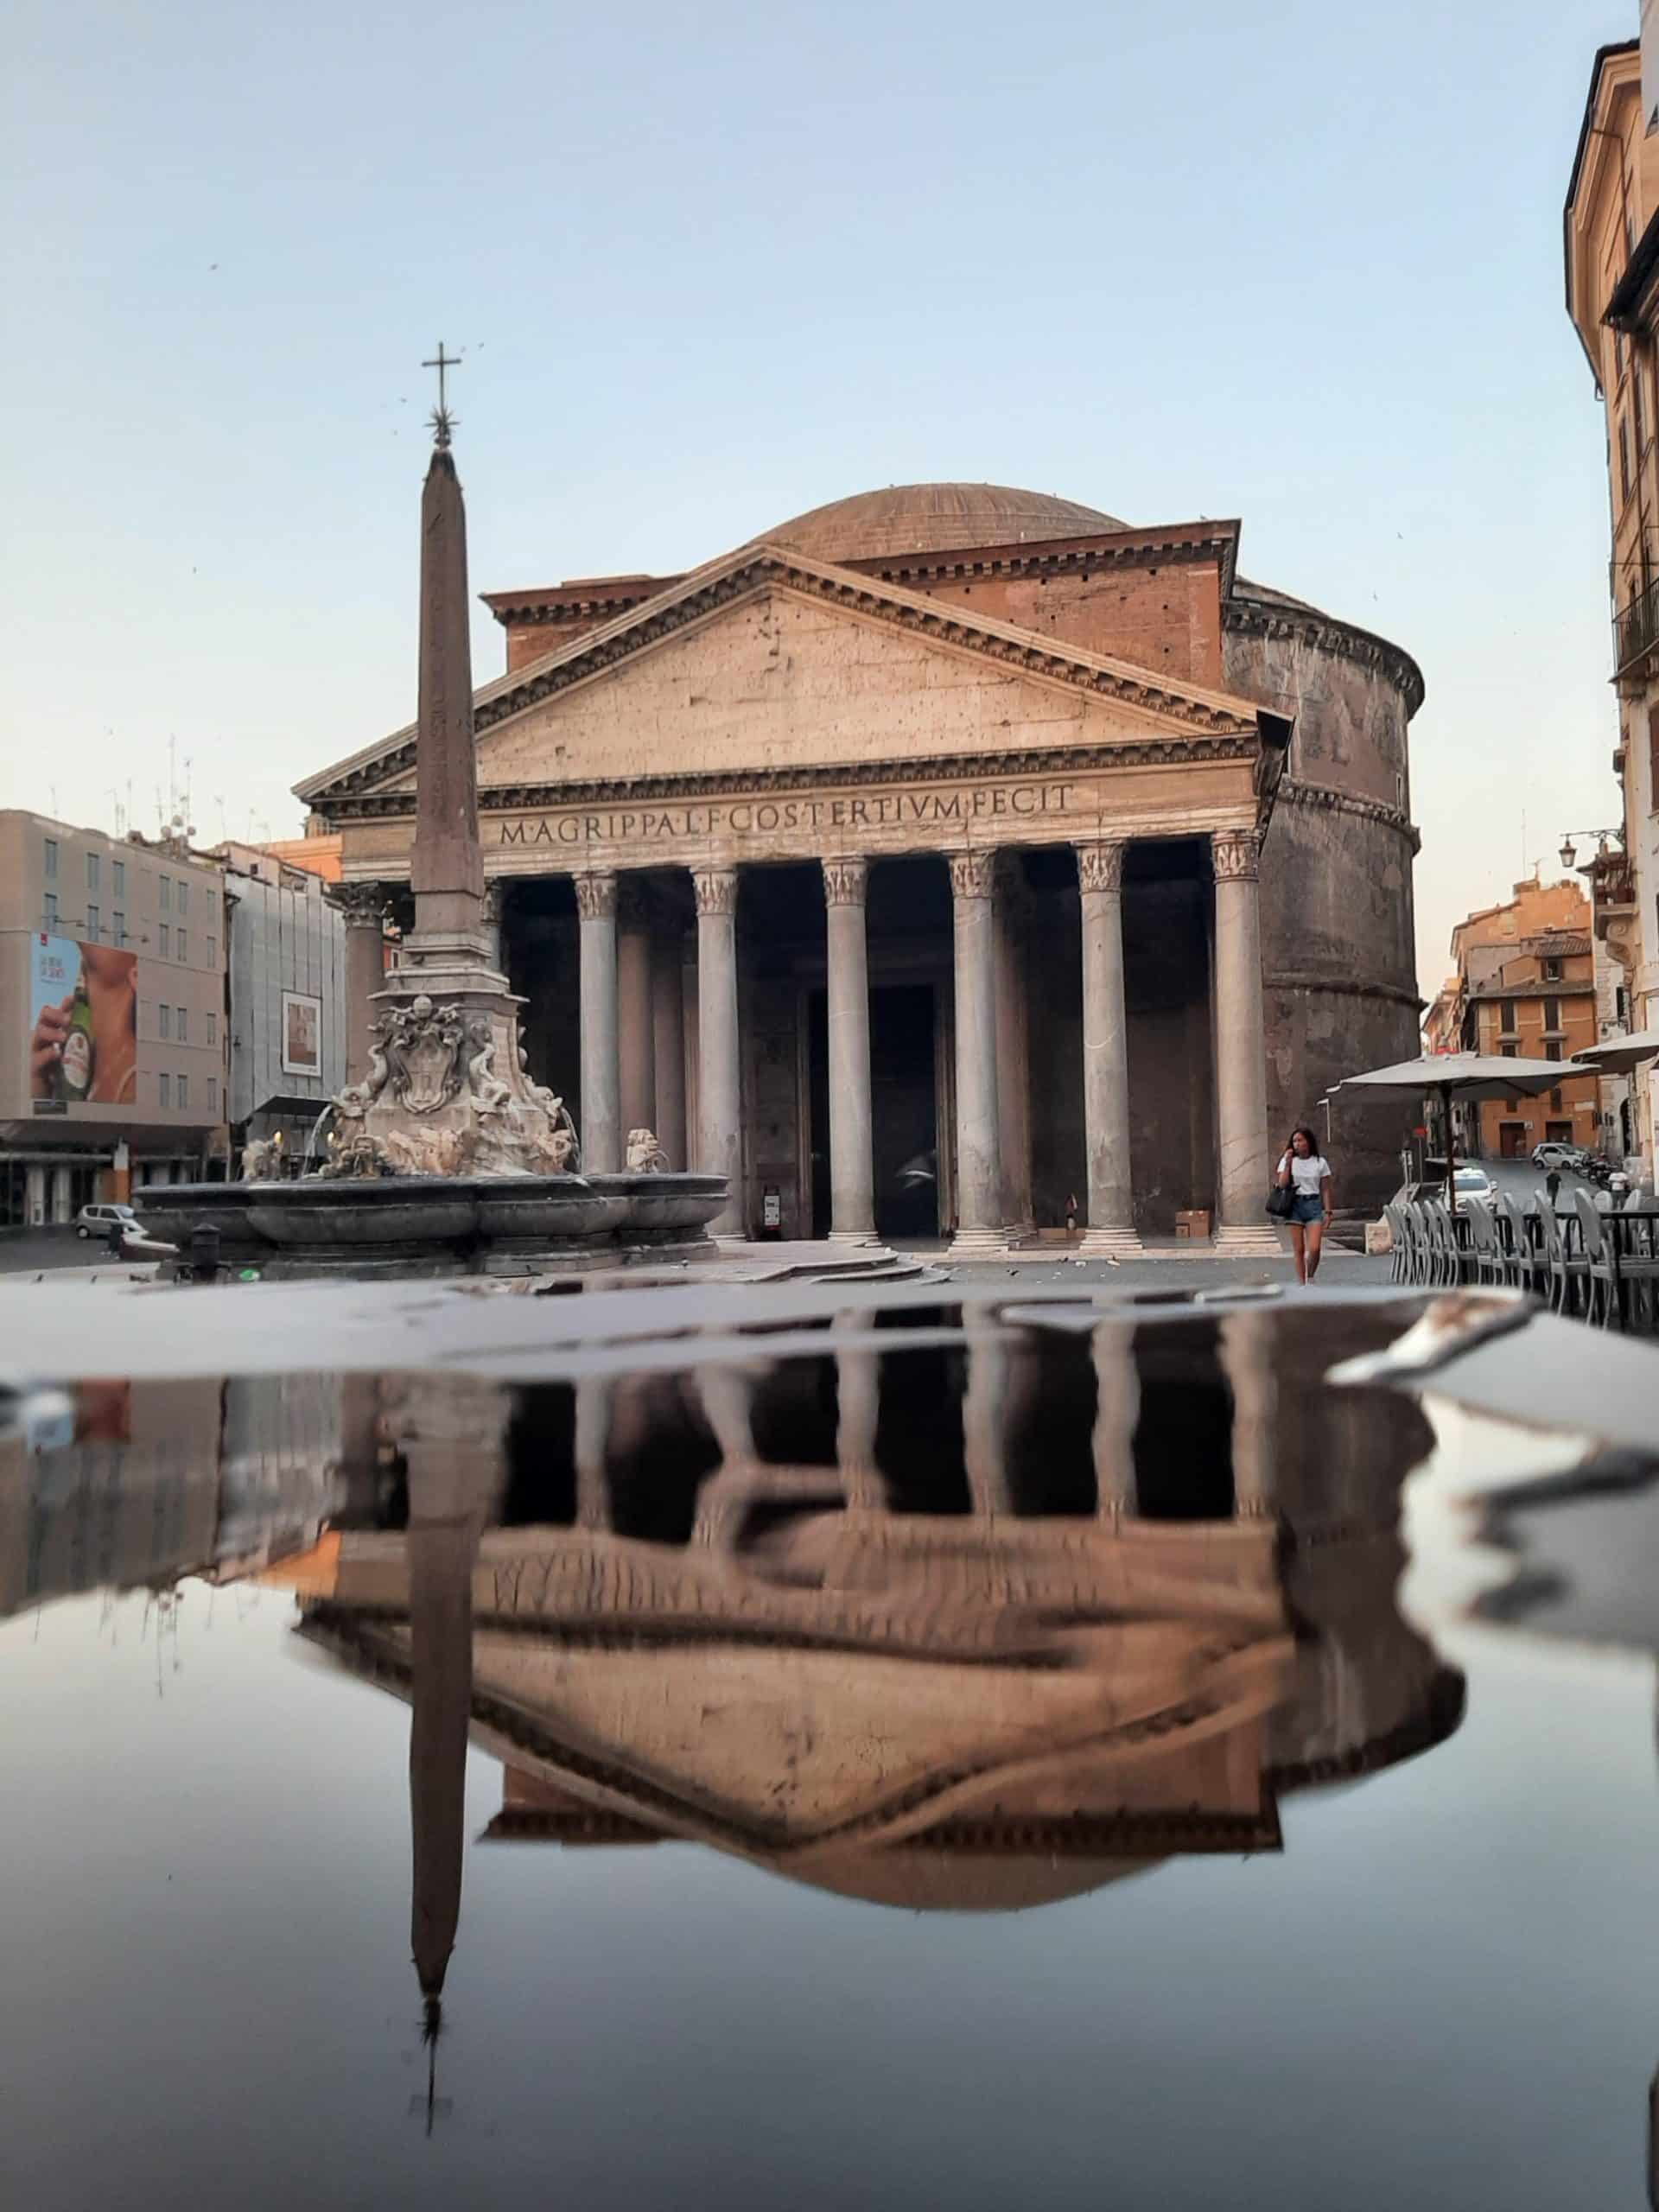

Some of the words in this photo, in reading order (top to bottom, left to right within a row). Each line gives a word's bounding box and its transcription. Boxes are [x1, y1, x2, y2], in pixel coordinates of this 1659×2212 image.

[534, 811, 675, 844] AGRIPPA
[729, 804, 798, 831] COS
[804, 793, 961, 826] TERTIVM
[971, 784, 1074, 817] FECIT
